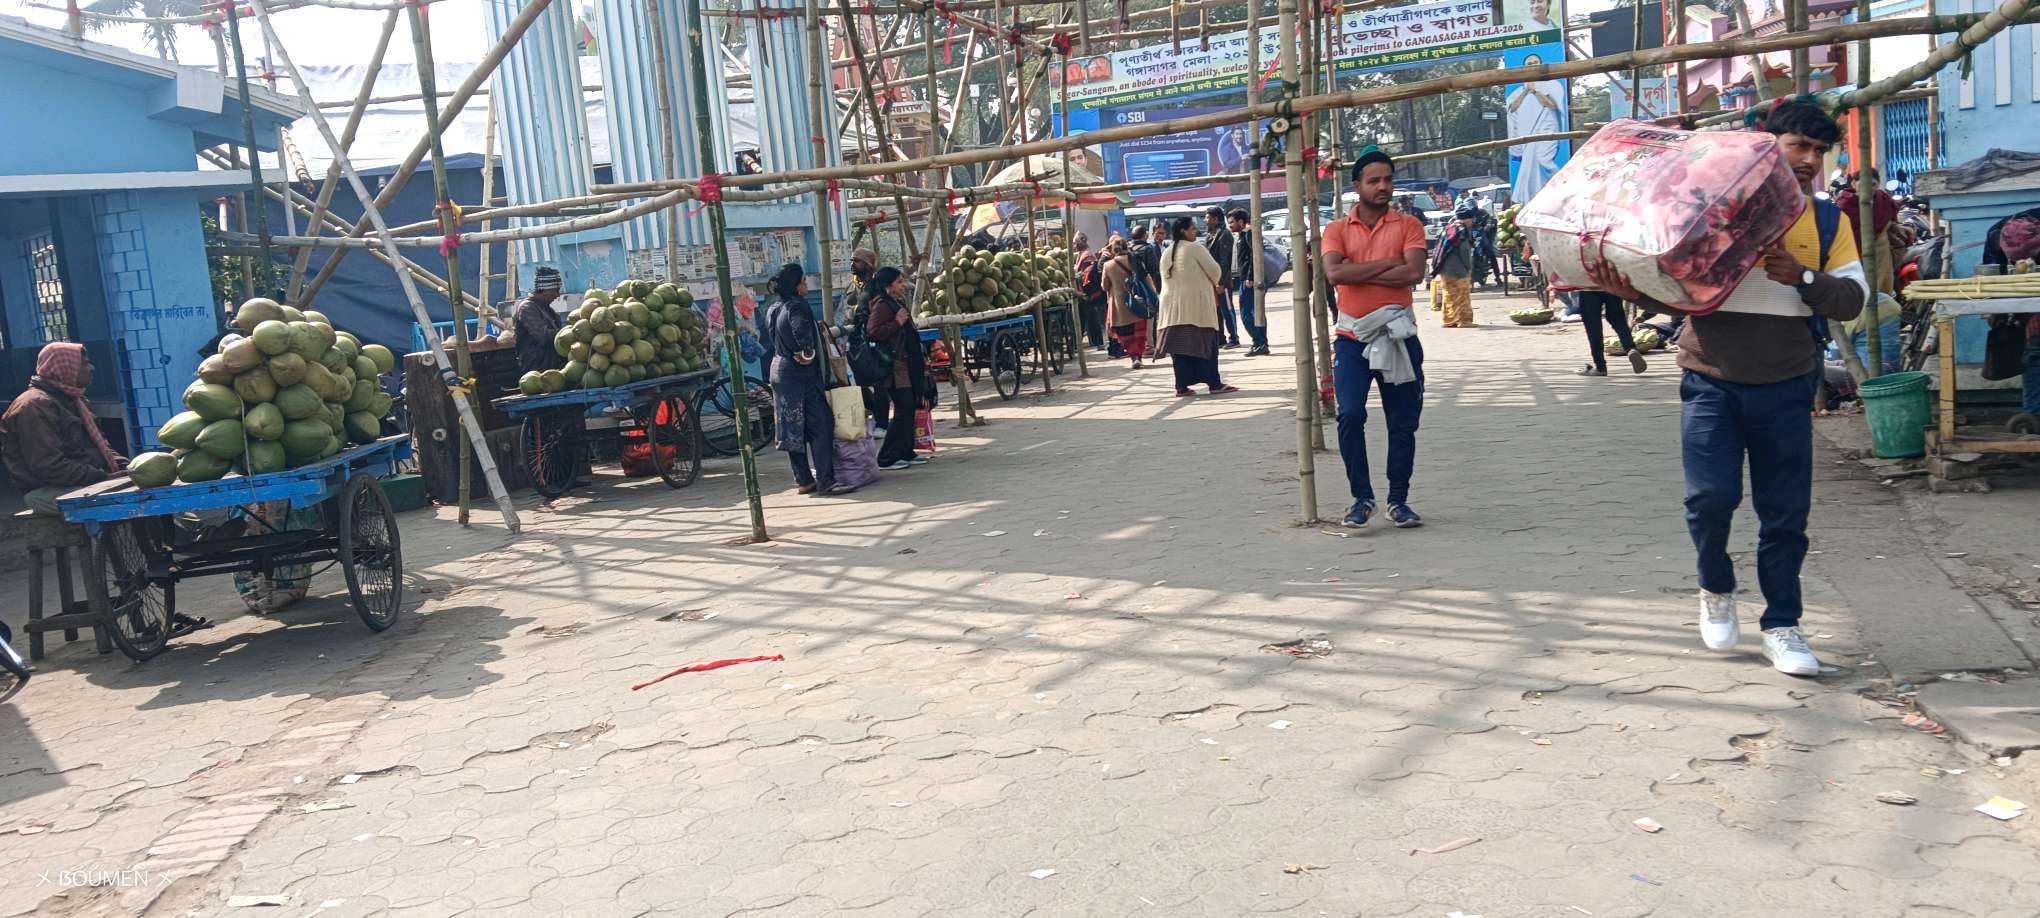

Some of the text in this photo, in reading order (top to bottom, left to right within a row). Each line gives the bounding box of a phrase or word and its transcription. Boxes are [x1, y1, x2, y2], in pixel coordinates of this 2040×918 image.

[1056, 85, 1118, 100] Sgar-Sangam,
[1132, 77, 1156, 89] abode
[1158, 76, 1168, 87] of
[1169, 65, 1221, 83] spirituality,
[1351, 42, 1390, 56] pilgrims
[1393, 40, 1403, 49] to
[1405, 30, 1471, 47] GANGASAGAR
[1473, 23, 1524, 38] MELA-2026
[1126, 60, 1177, 77] গঙ্গাসাগর
[1224, 50, 1250, 62] ২০২
[1407, 23, 1424, 33] ও
[1430, 13, 1490, 32] স্বাগত
[1127, 111, 1146, 123] SBI
